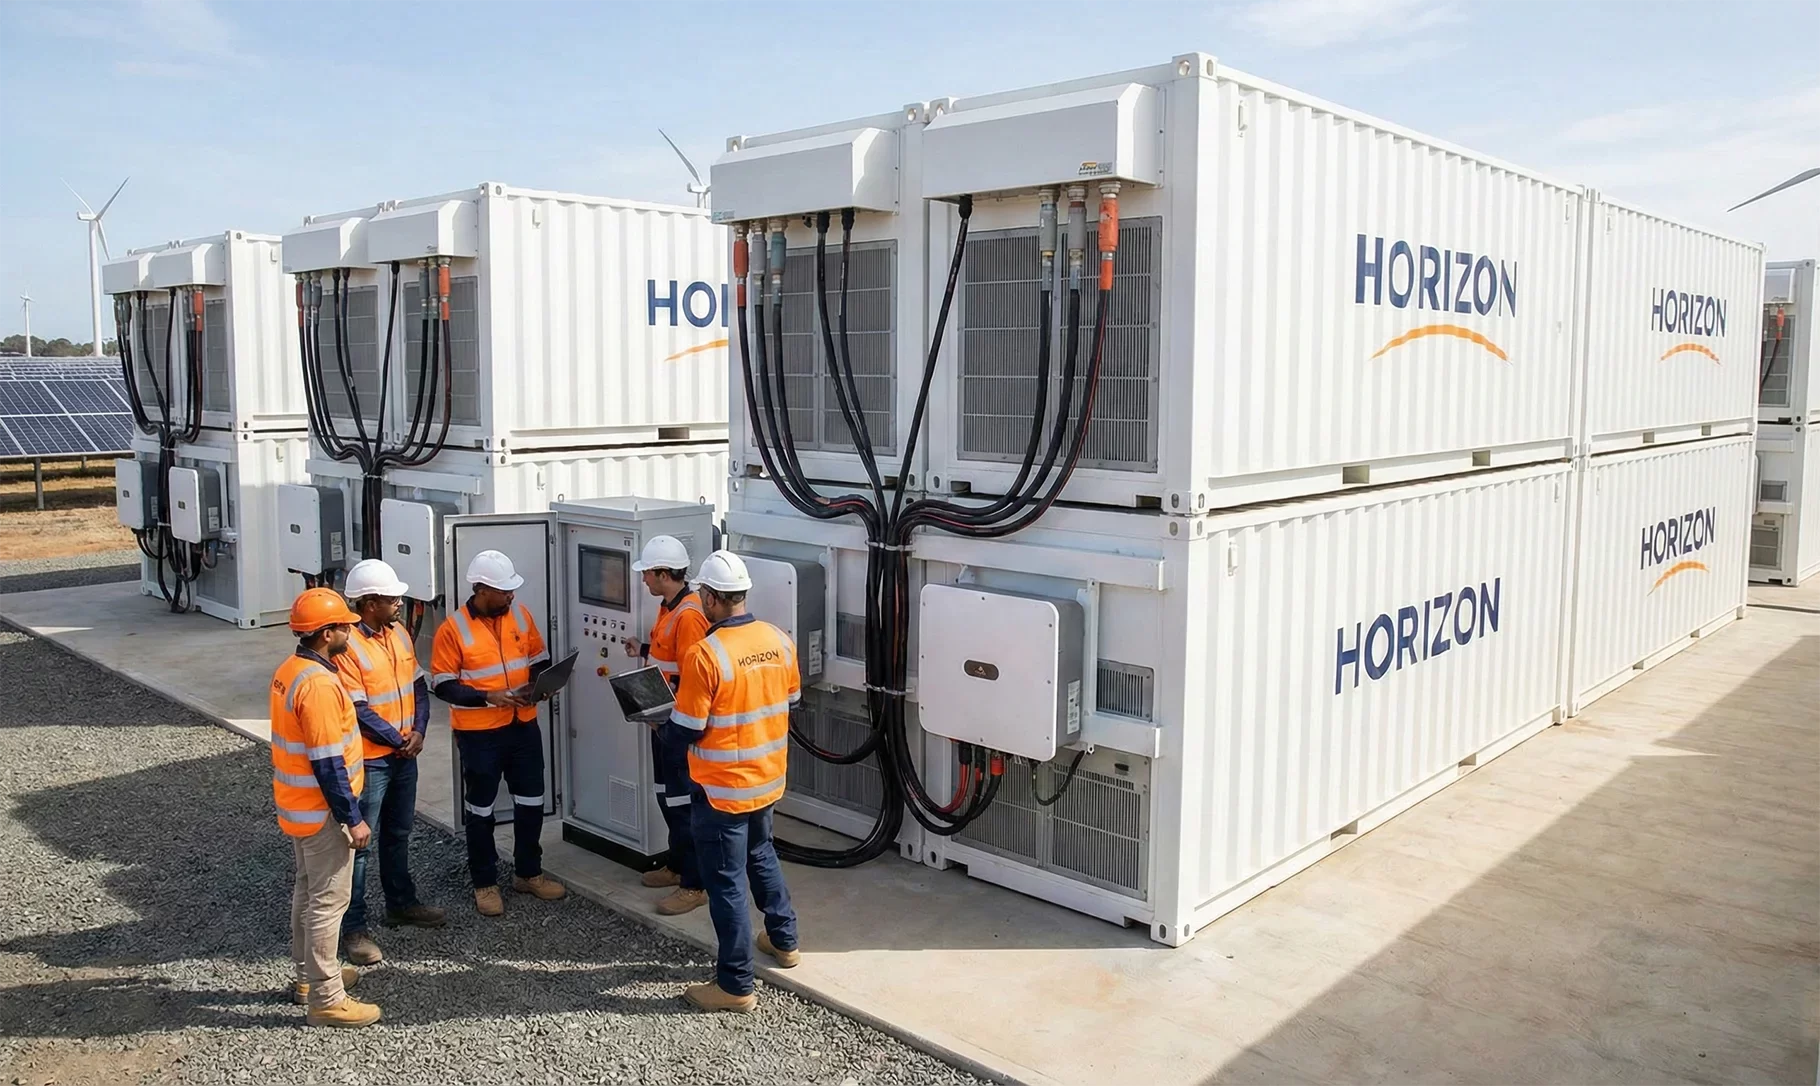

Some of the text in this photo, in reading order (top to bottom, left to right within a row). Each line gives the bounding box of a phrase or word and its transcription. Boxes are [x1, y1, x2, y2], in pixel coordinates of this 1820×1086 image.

[647, 279, 729, 328] HO
[1355, 233, 1517, 318] HORIZON
[1651, 287, 1727, 338] HORIZON
[1640, 506, 1716, 571] HORIZON
[737, 649, 780, 667] HORIZON
[1335, 577, 1501, 695] HORIZON
